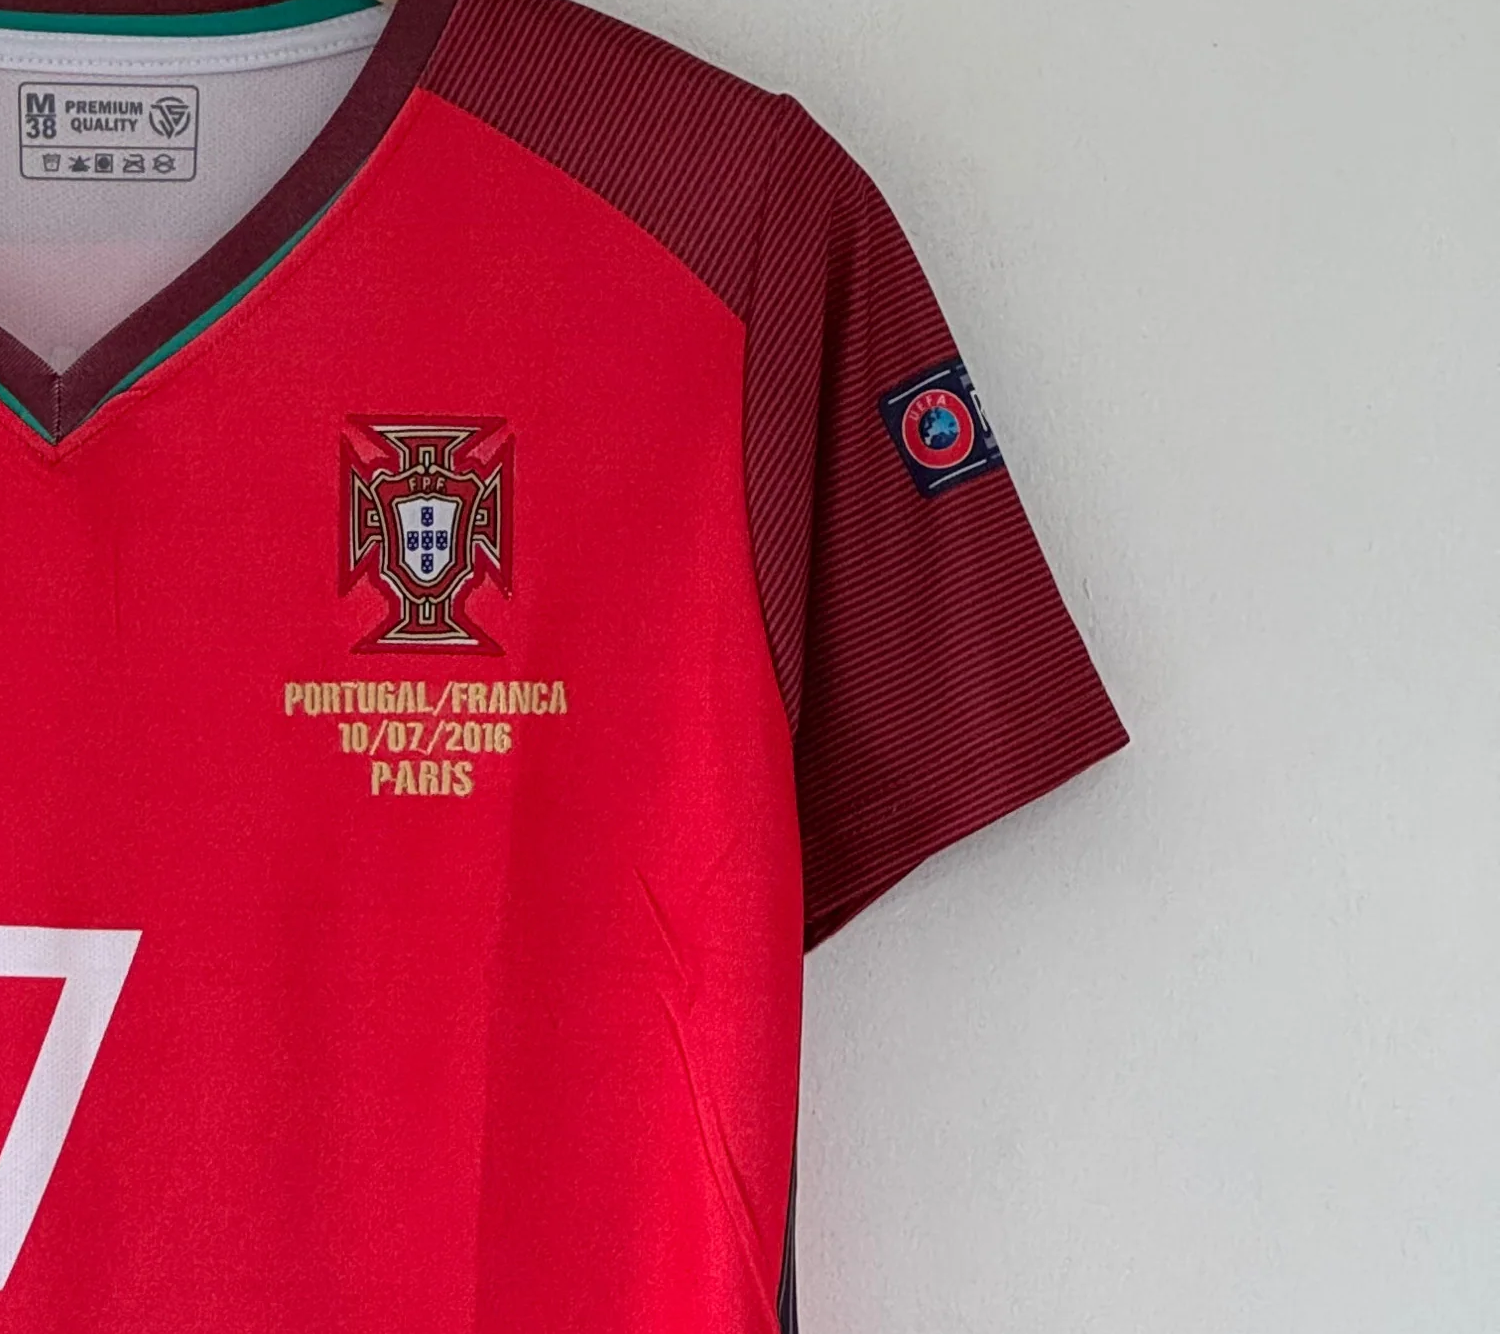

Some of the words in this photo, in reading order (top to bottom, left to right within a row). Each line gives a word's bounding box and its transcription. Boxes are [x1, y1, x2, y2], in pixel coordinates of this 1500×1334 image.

[26, 93, 55, 113] M
[65, 100, 143, 115] PREMIUM
[26, 118, 57, 139] 38
[70, 117, 139, 133] QUALITY
[910, 394, 947, 421] UEFA
[285, 680, 568, 716] PORTUGAL/FRANCA
[338, 719, 512, 756] 10/07/2016
[371, 760, 475, 796] PARIS
